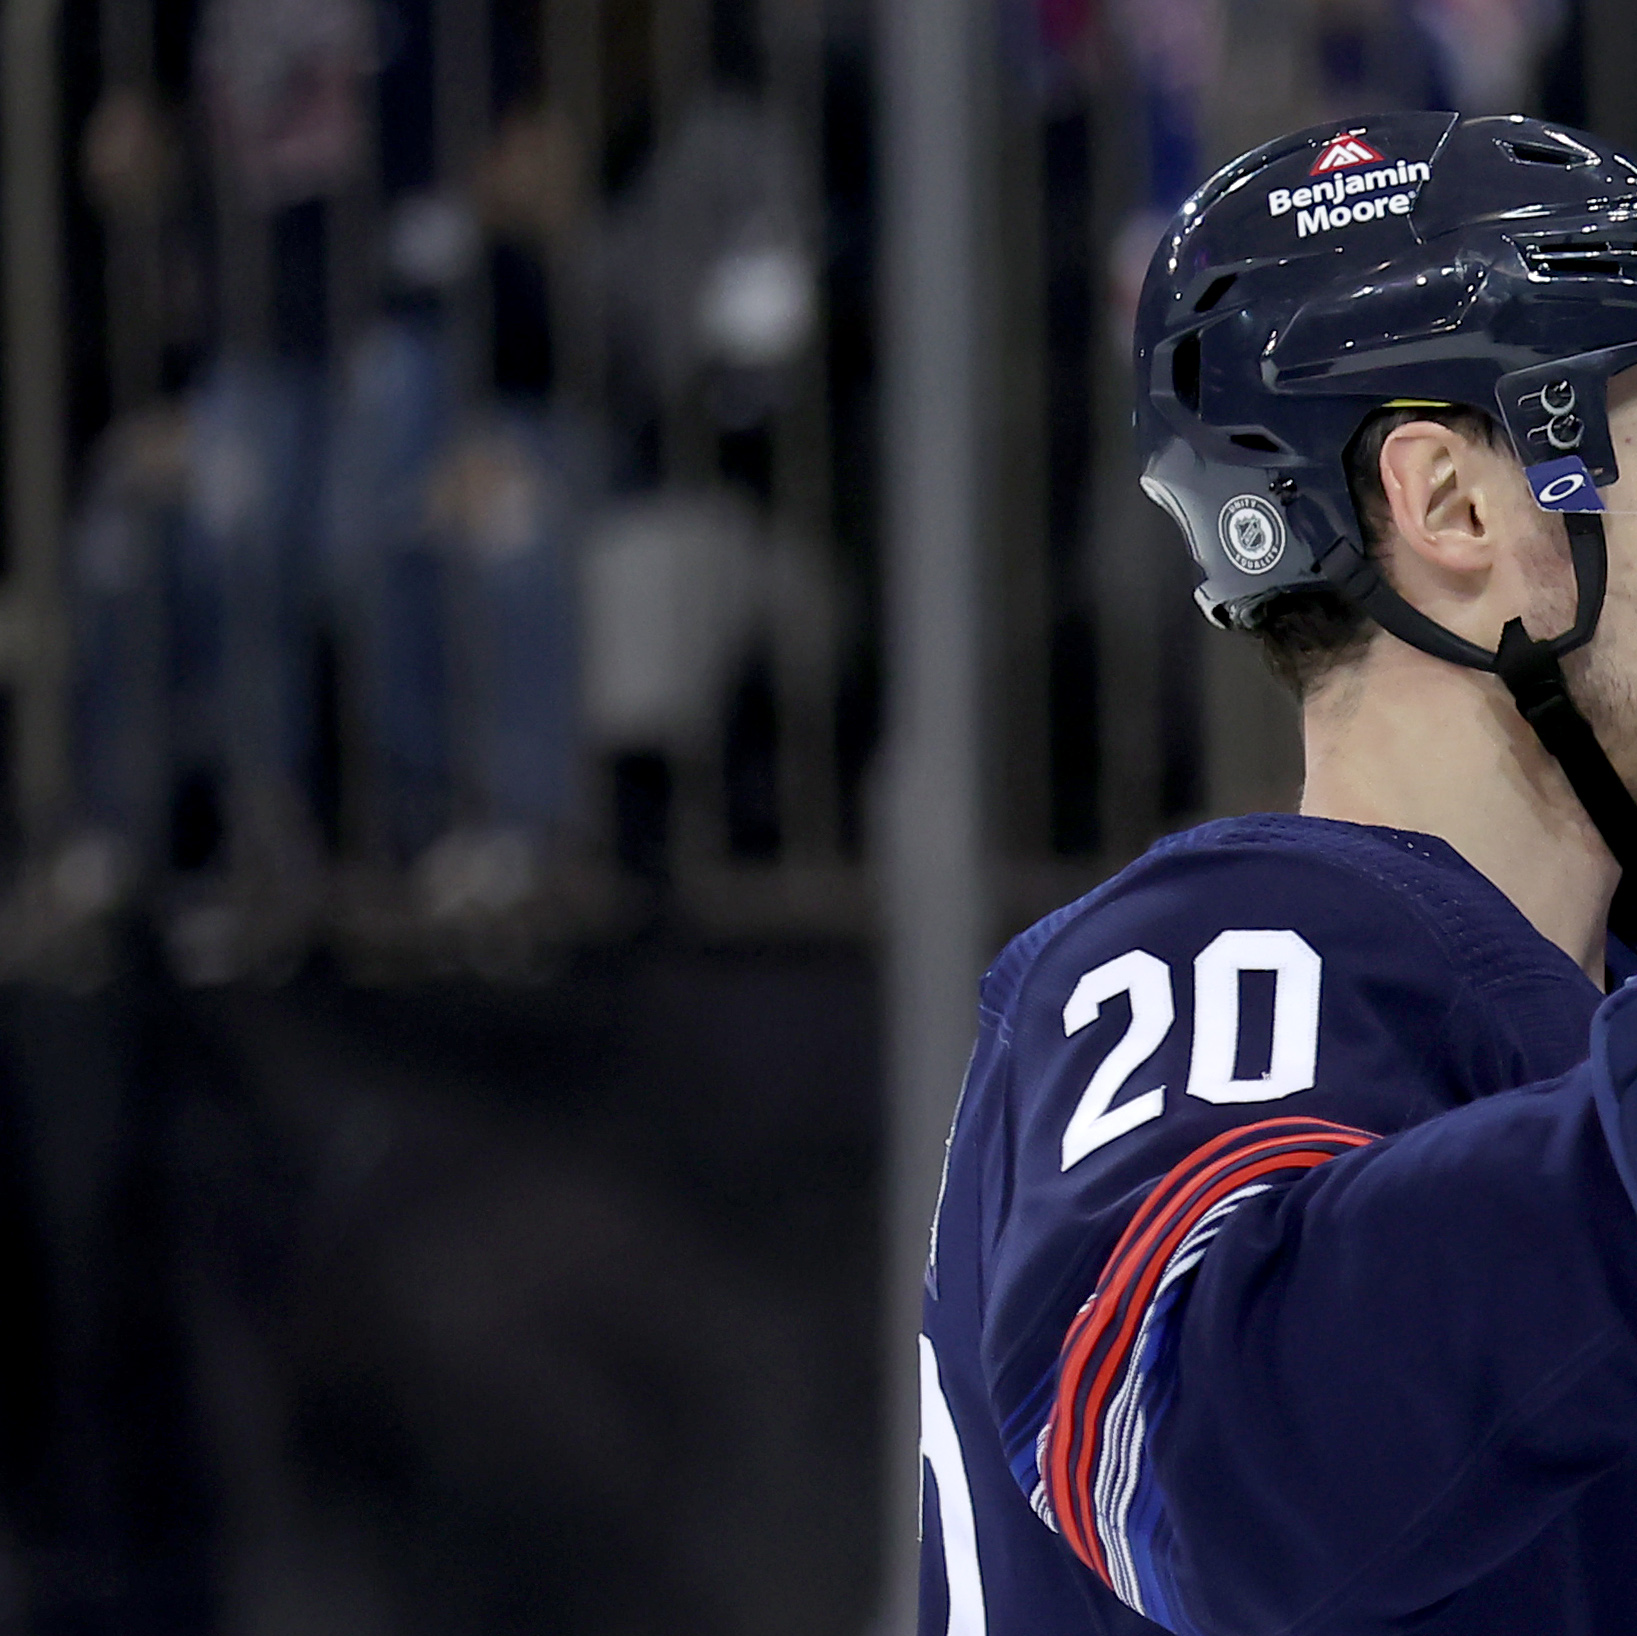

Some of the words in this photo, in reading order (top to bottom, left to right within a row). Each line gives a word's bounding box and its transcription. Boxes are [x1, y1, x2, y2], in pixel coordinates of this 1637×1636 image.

[1268, 160, 1430, 216] Benjamin
[1297, 193, 1411, 238] Moore
[1061, 929, 1322, 1172] 20
